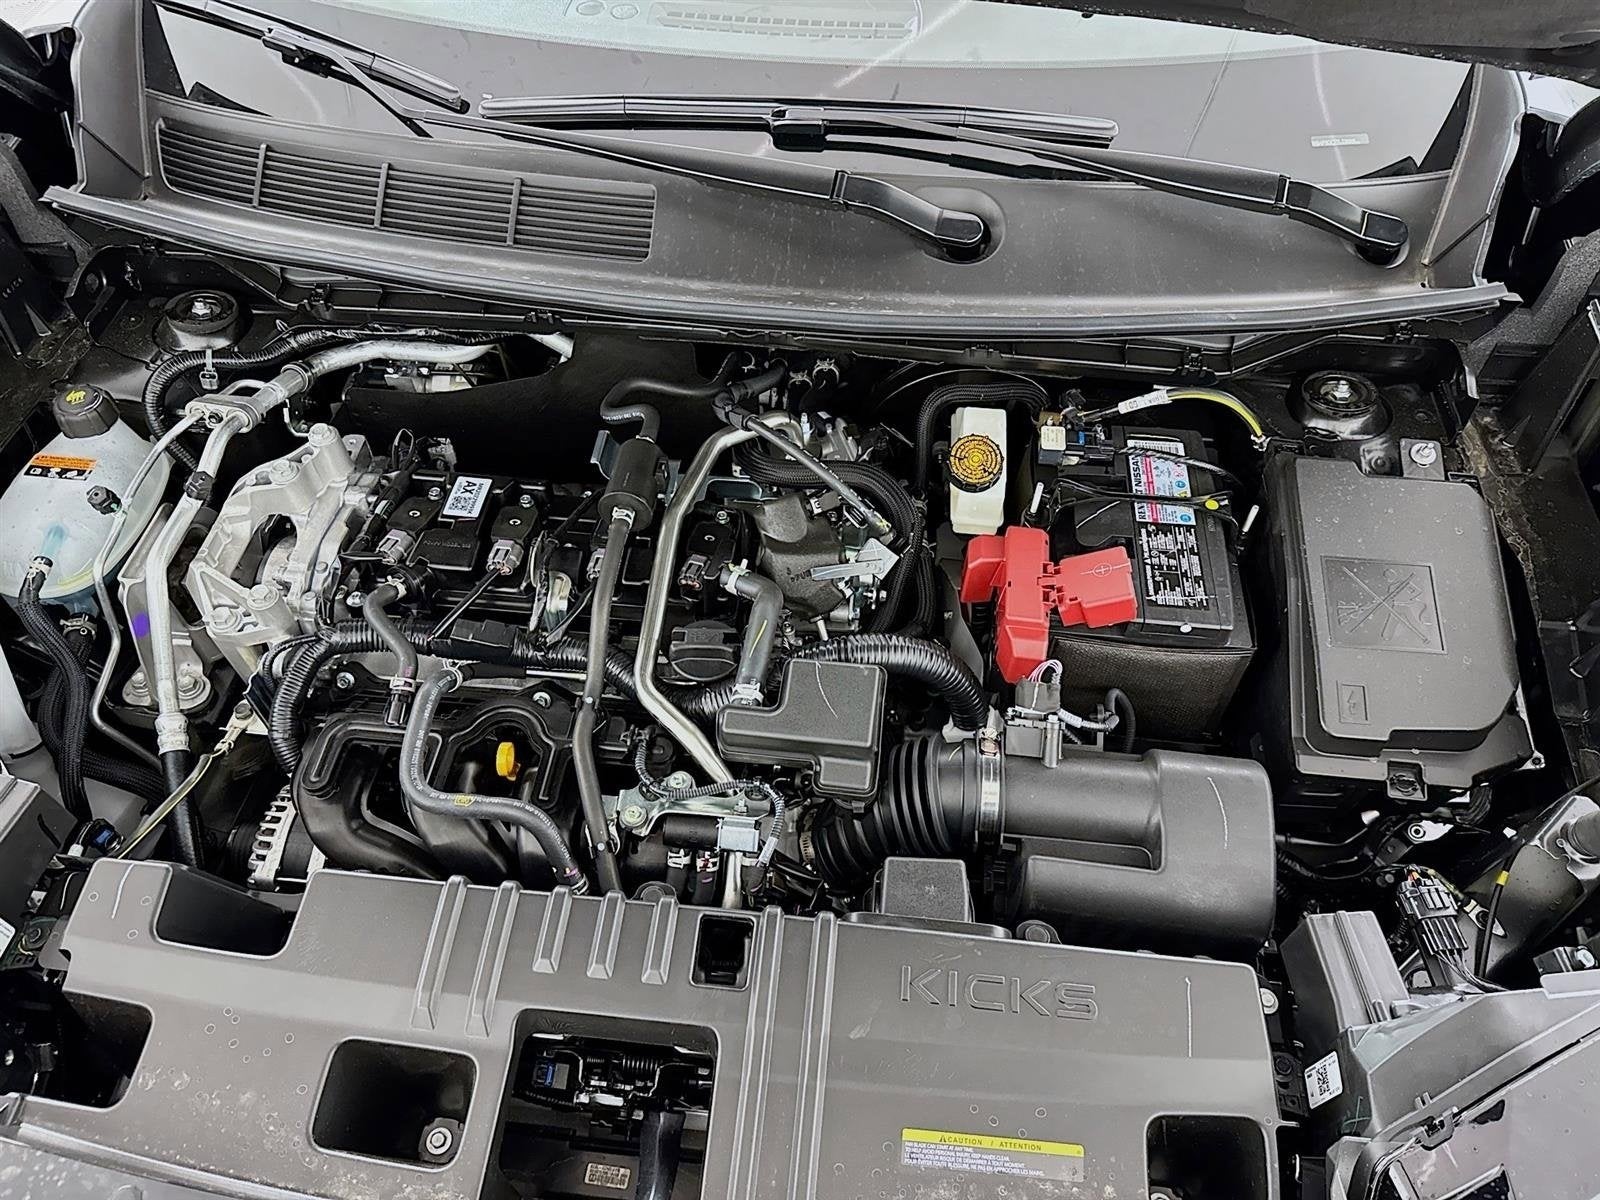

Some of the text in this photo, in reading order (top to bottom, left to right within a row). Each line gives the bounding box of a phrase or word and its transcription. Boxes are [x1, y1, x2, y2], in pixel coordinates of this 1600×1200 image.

[460, 480, 478, 494] AX
[901, 966, 1098, 1020] KICKS
[948, 1136, 982, 1146] CAUTION
[999, 1141, 1042, 1151] ATTENTION
